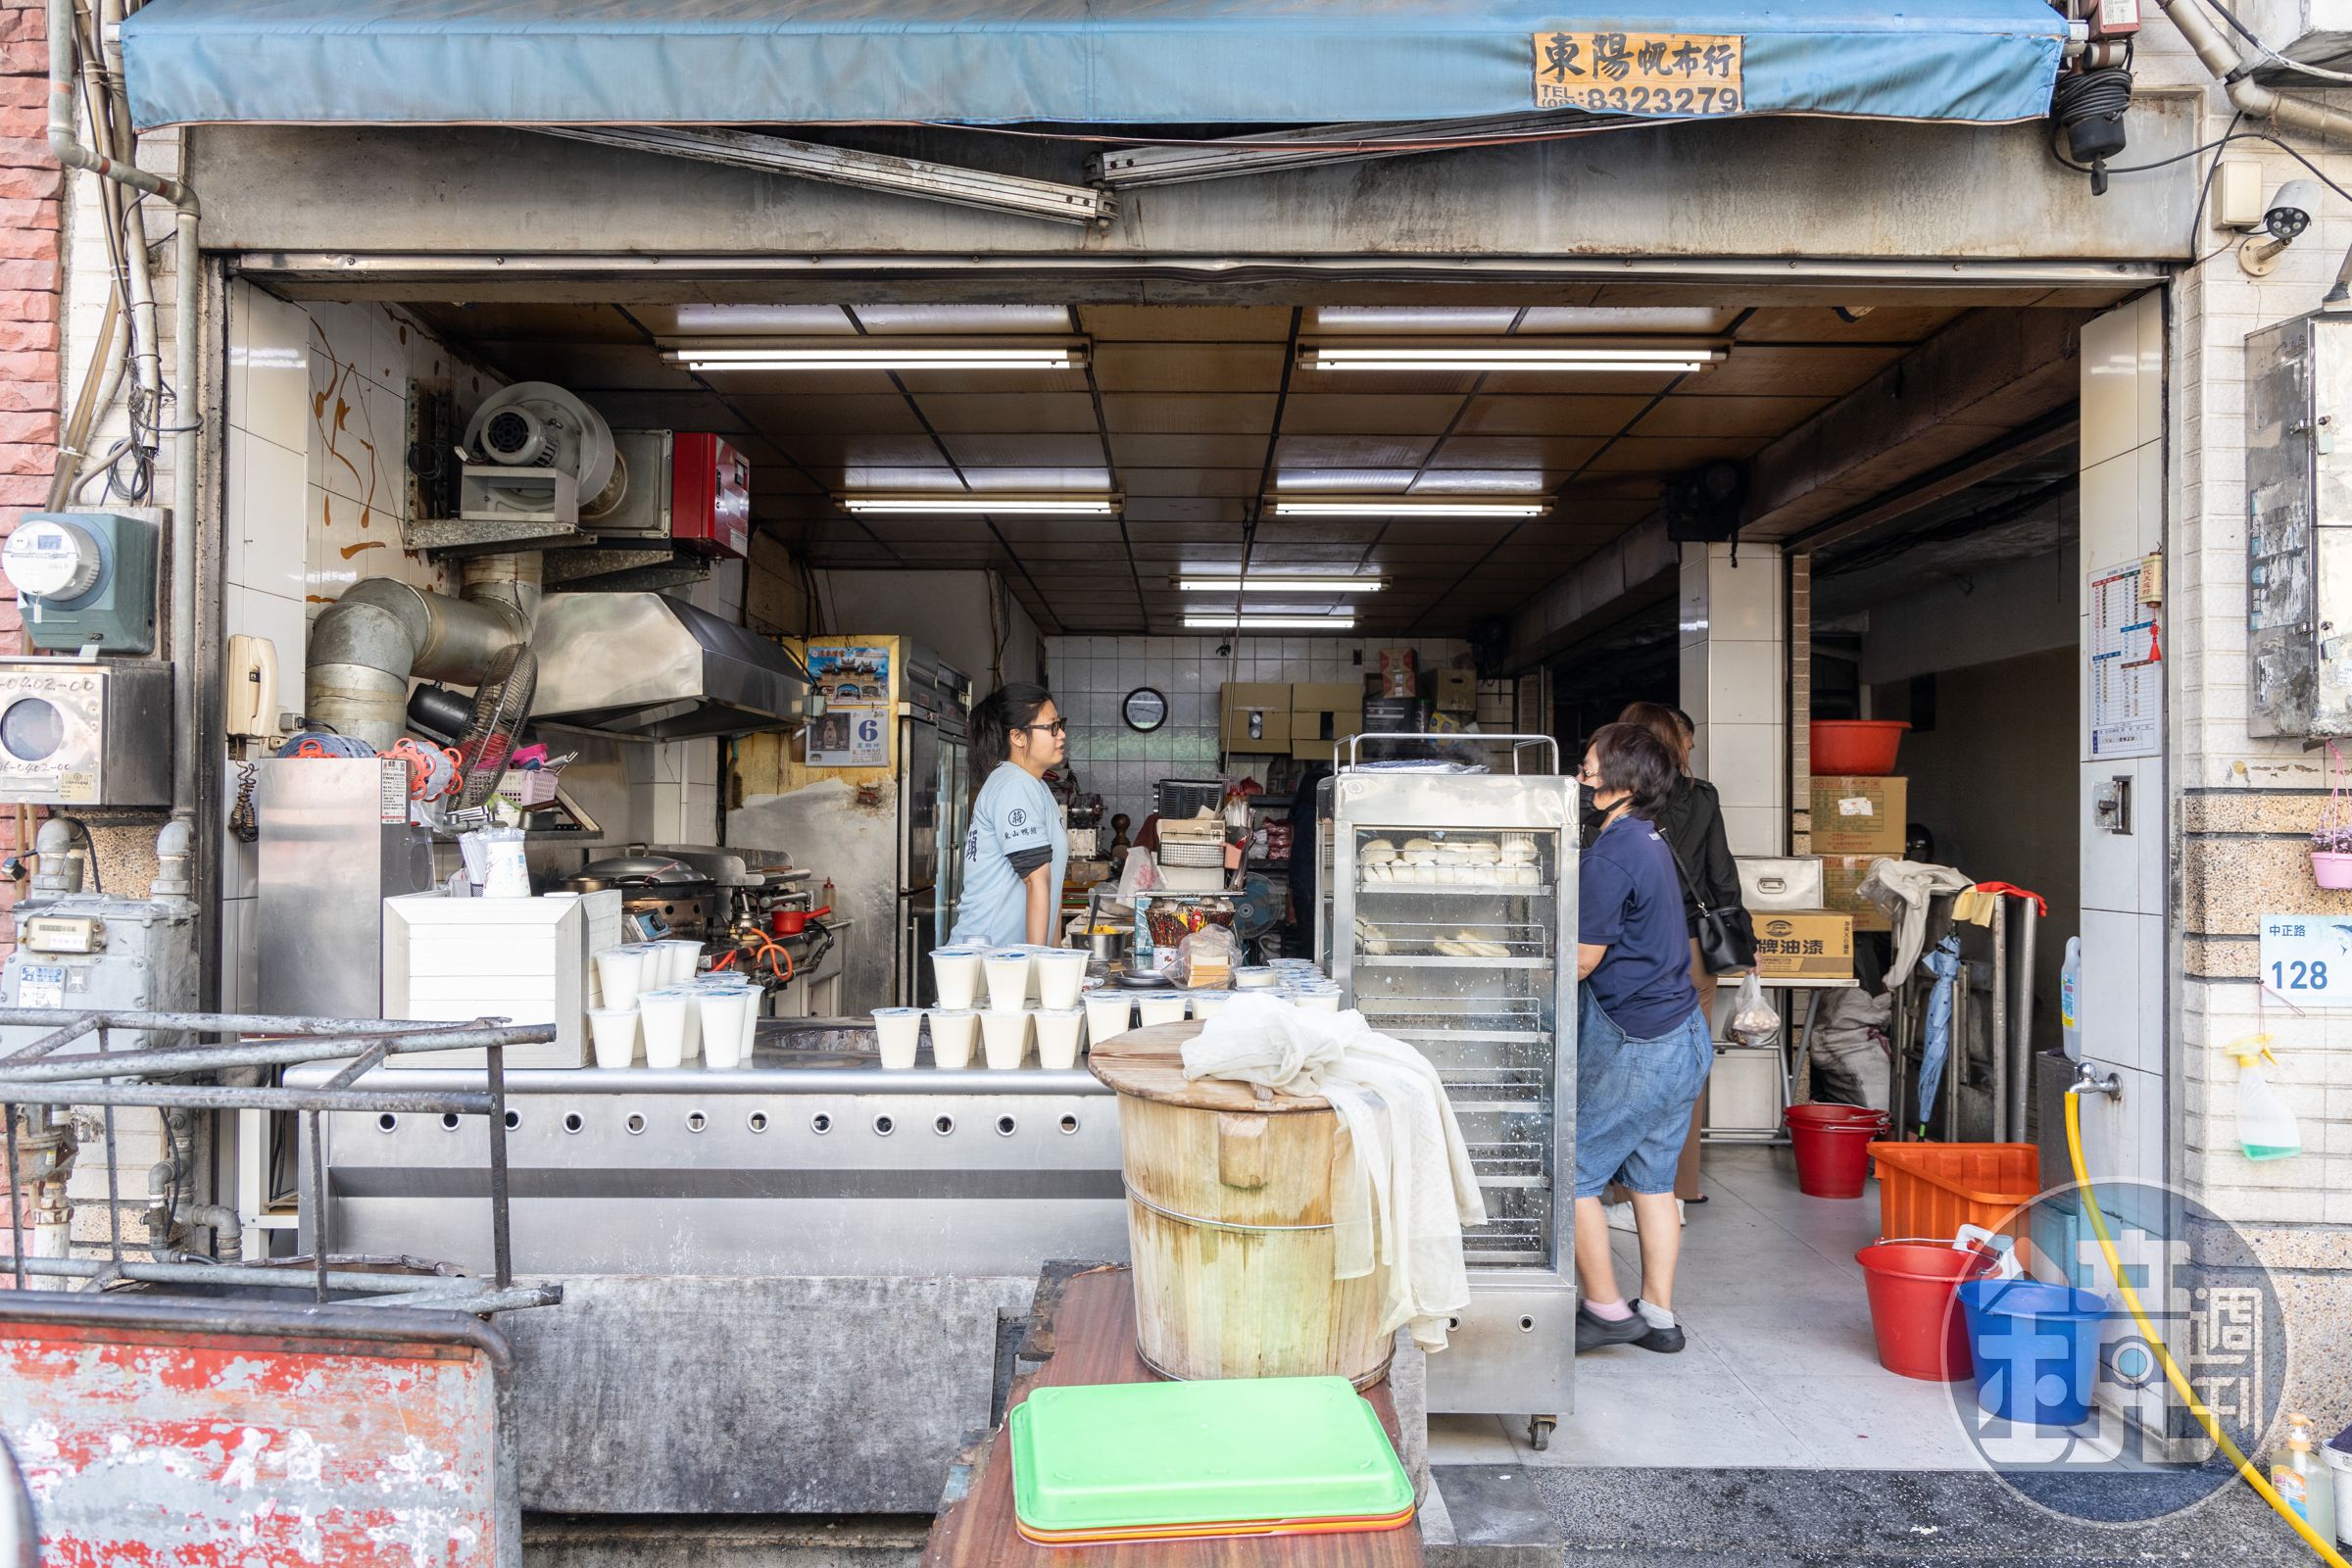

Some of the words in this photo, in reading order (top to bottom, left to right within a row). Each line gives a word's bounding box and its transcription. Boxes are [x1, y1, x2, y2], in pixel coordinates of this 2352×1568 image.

[1541, 32, 1737, 83] 東陽帆布行
[1587, 86, 1739, 114] 8323279
[858, 719, 878, 742] 6
[2269, 924, 2306, 937] 中正路
[2272, 960, 2328, 990] 128
